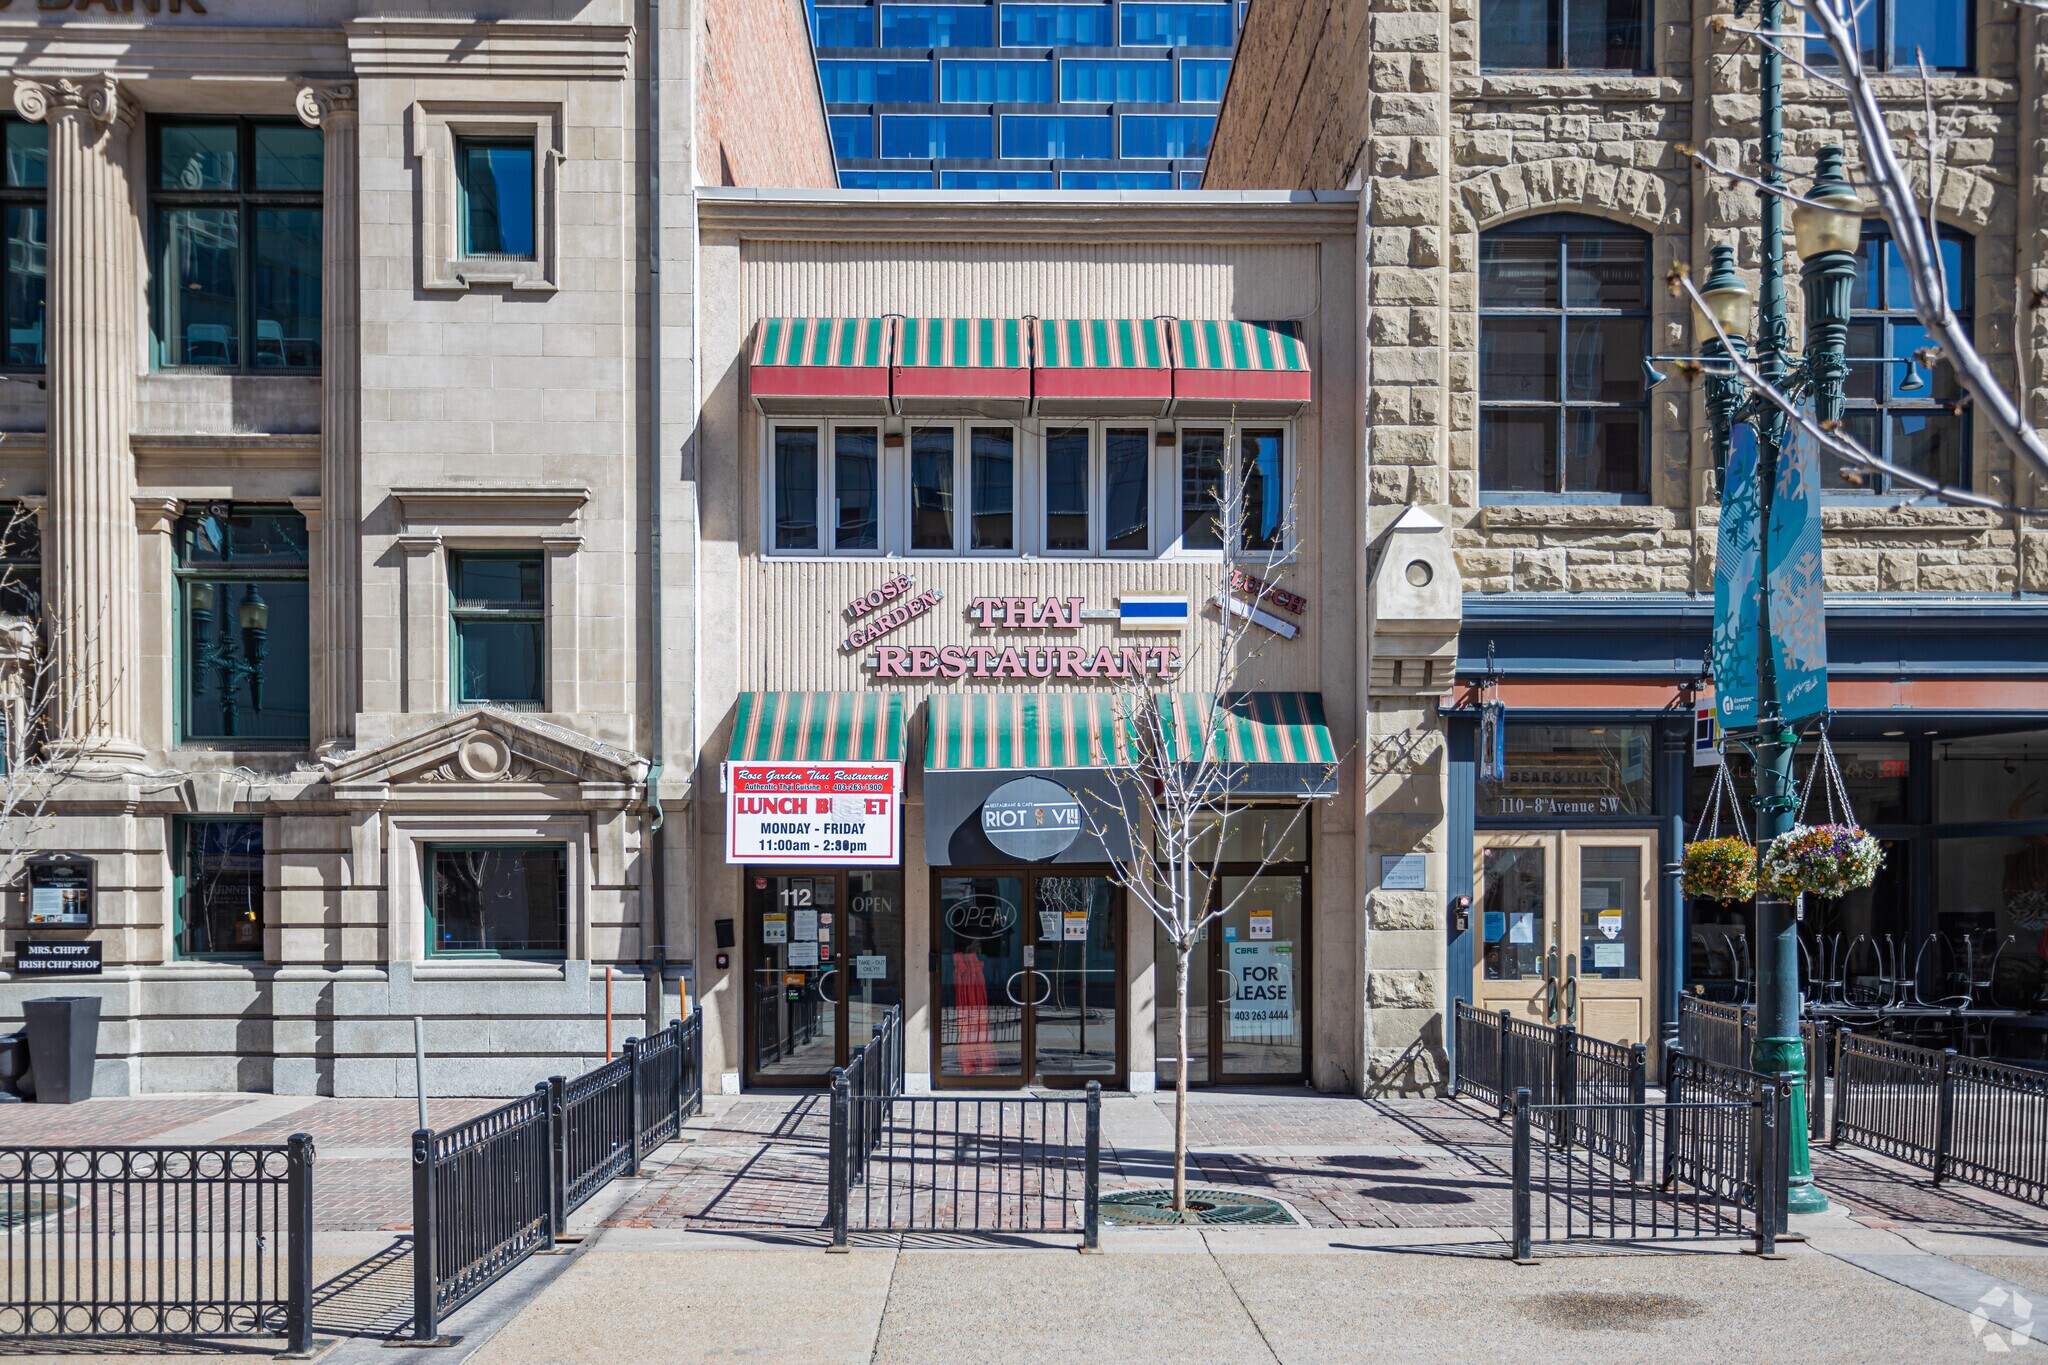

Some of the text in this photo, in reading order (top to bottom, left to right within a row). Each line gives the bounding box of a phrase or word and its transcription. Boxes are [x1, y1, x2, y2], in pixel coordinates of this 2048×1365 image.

[850, 574, 912, 617] ROSE
[1230, 569, 1307, 615] LUNCH
[849, 589, 938, 648] GARDEN
[972, 596, 1085, 629] THAI
[875, 644, 1181, 678] RESTAURANT
[738, 769, 889, 783] Rose Garden Thai Restaurant
[779, 783, 794, 791] Thai
[832, 783, 883, 791] 403-263-1900
[737, 797, 808, 814] LUNCH
[1548, 798, 1595, 813] Avenue
[1599, 796, 1620, 813] SW
[985, 809, 1027, 827] RIOT
[760, 823, 811, 834] MONDAY
[823, 823, 866, 834] FRIDAY
[758, 839, 810, 851] 11:00am
[780, 888, 812, 906] 112
[852, 896, 892, 912] OPEN
[950, 906, 1010, 927] OPEN
[28, 946, 90, 954] MRS. CHIPPY
[18, 960, 100, 969] IRISH CHIP SHOP
[1242, 966, 1279, 982] FOR
[1235, 985, 1287, 1001] LEASE
[1234, 1010, 1289, 1021] 403 263 4444
